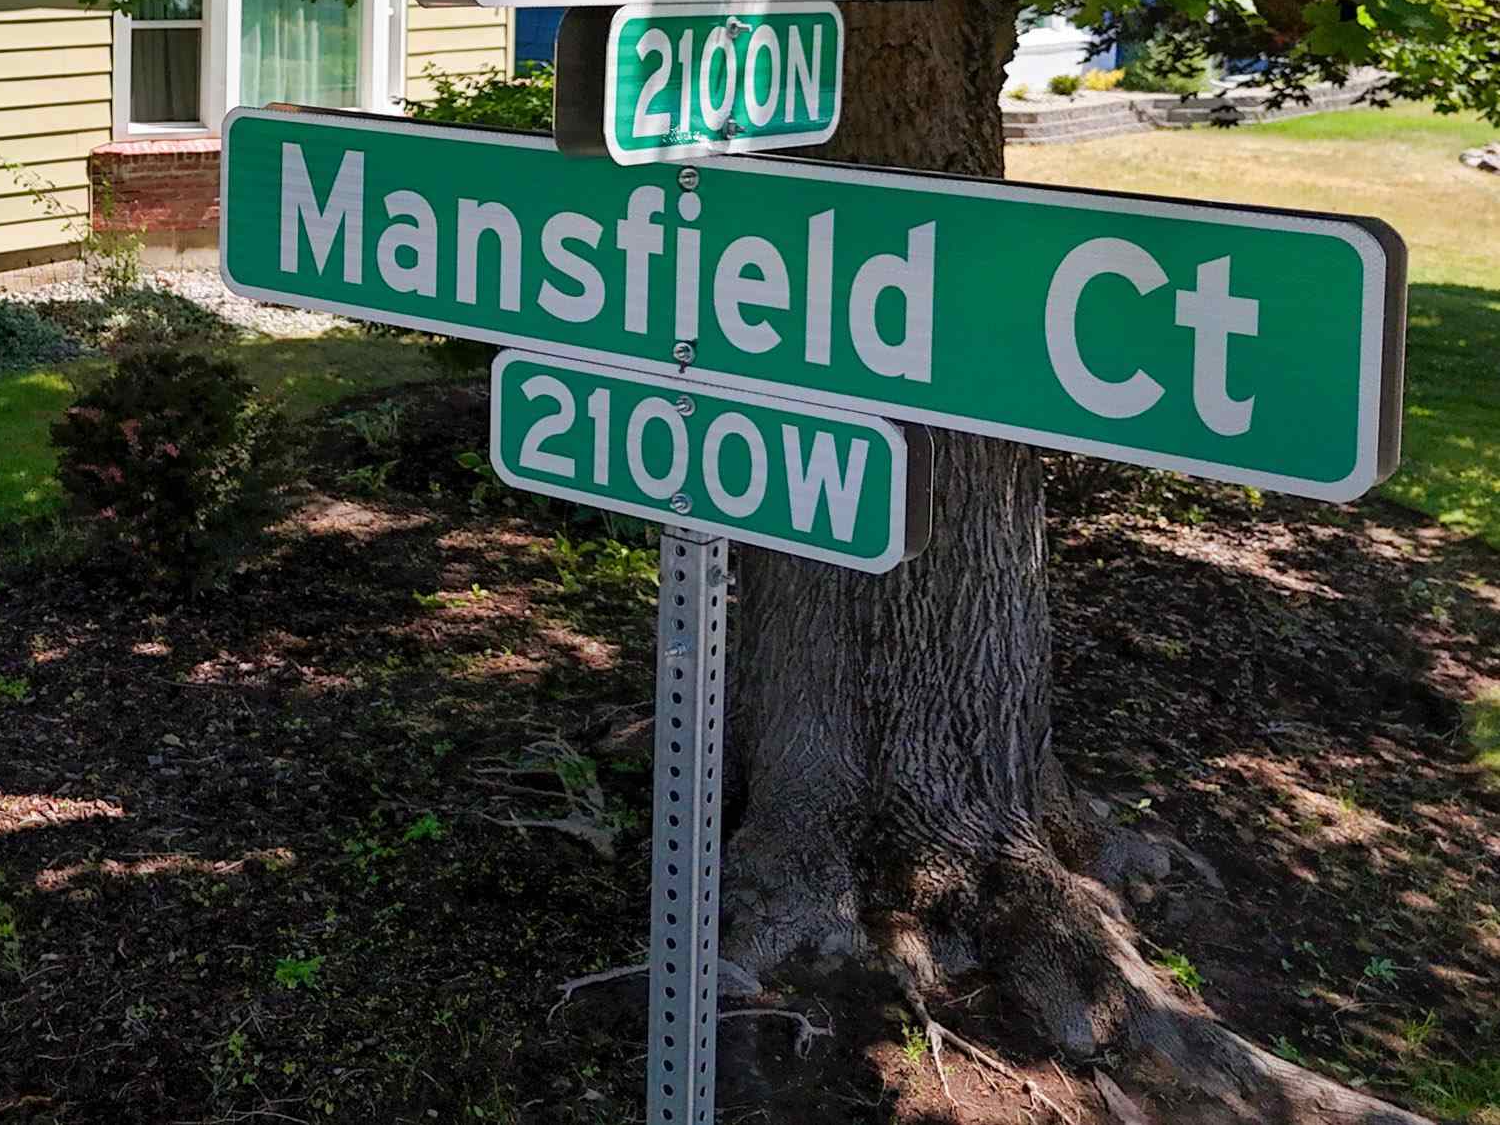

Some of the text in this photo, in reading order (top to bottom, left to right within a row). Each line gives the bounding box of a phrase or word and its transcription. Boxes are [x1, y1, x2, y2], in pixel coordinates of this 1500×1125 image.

[633, 24, 823, 138] 2100N
[280, 143, 1259, 436] Mansfield Ct
[518, 375, 870, 542] 2100W
